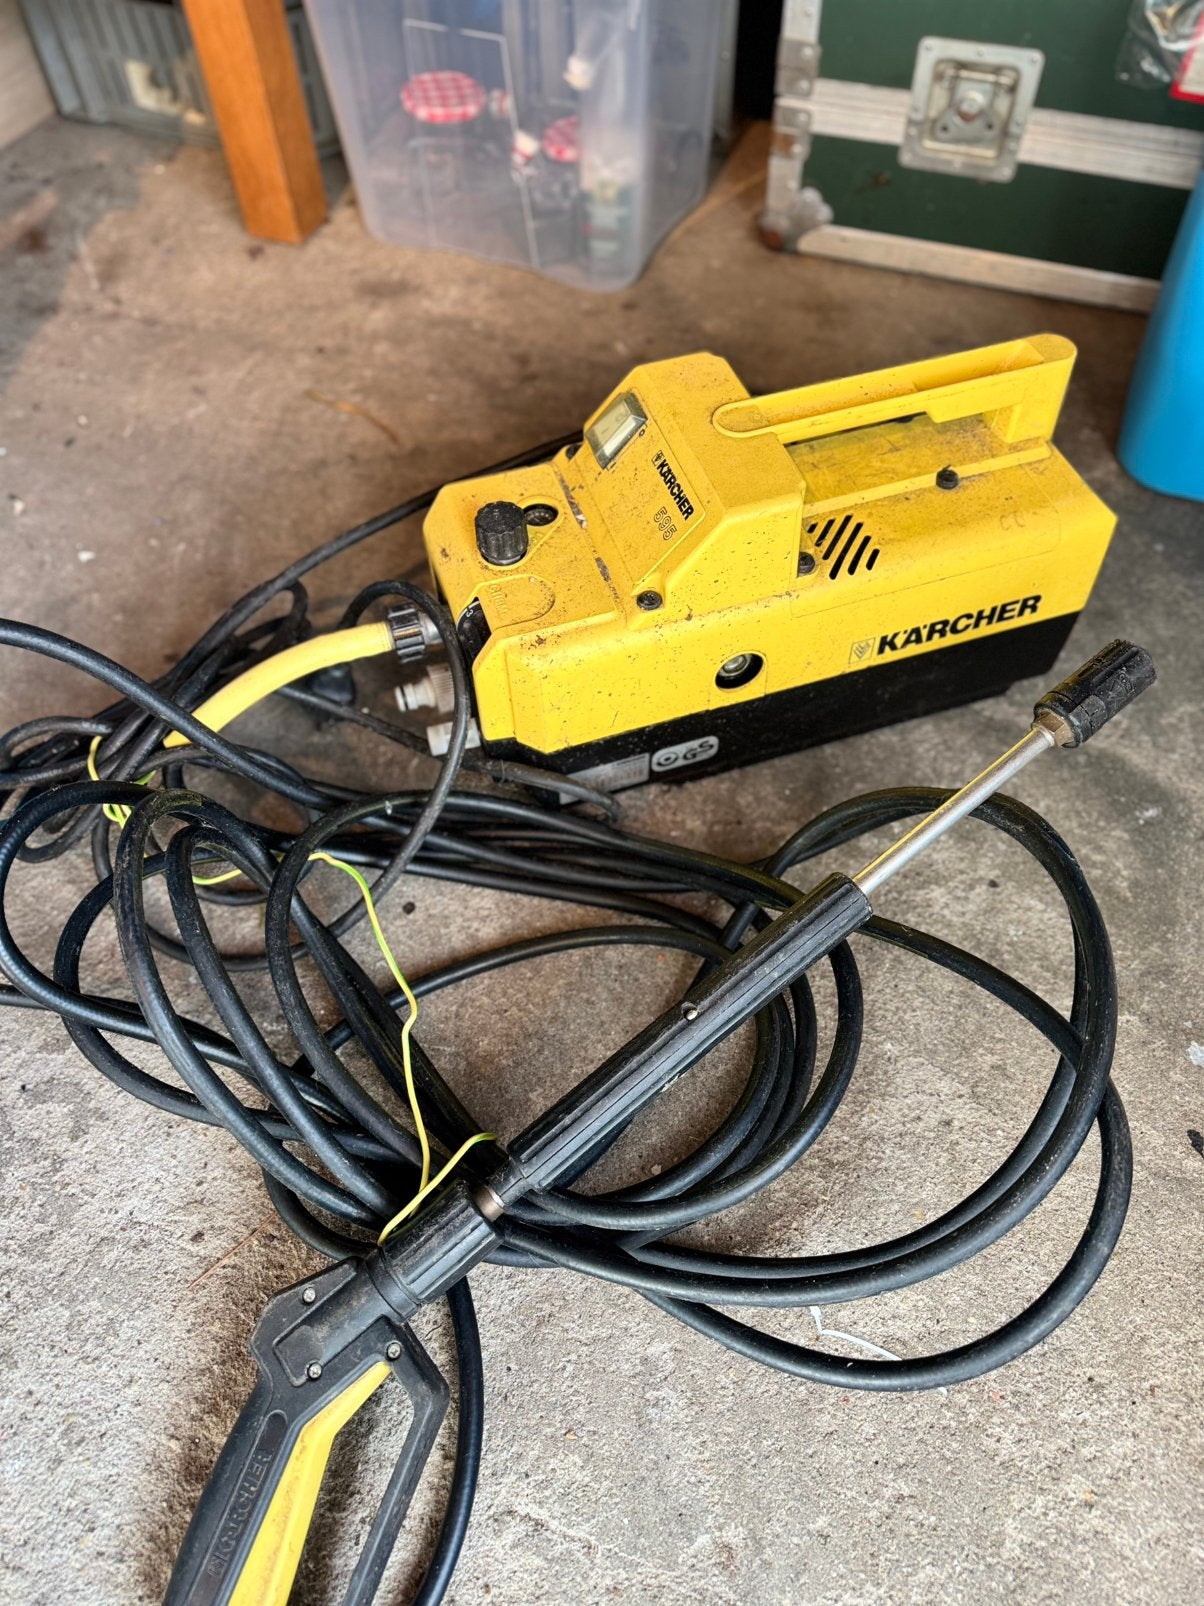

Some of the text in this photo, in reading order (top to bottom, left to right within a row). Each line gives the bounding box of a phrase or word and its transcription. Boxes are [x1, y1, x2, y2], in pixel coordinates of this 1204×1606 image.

[656, 458, 695, 521] KÄRCHER
[653, 506, 677, 540] 595
[877, 594, 1042, 656] KÄRCHER
[683, 740, 714, 761] GS
